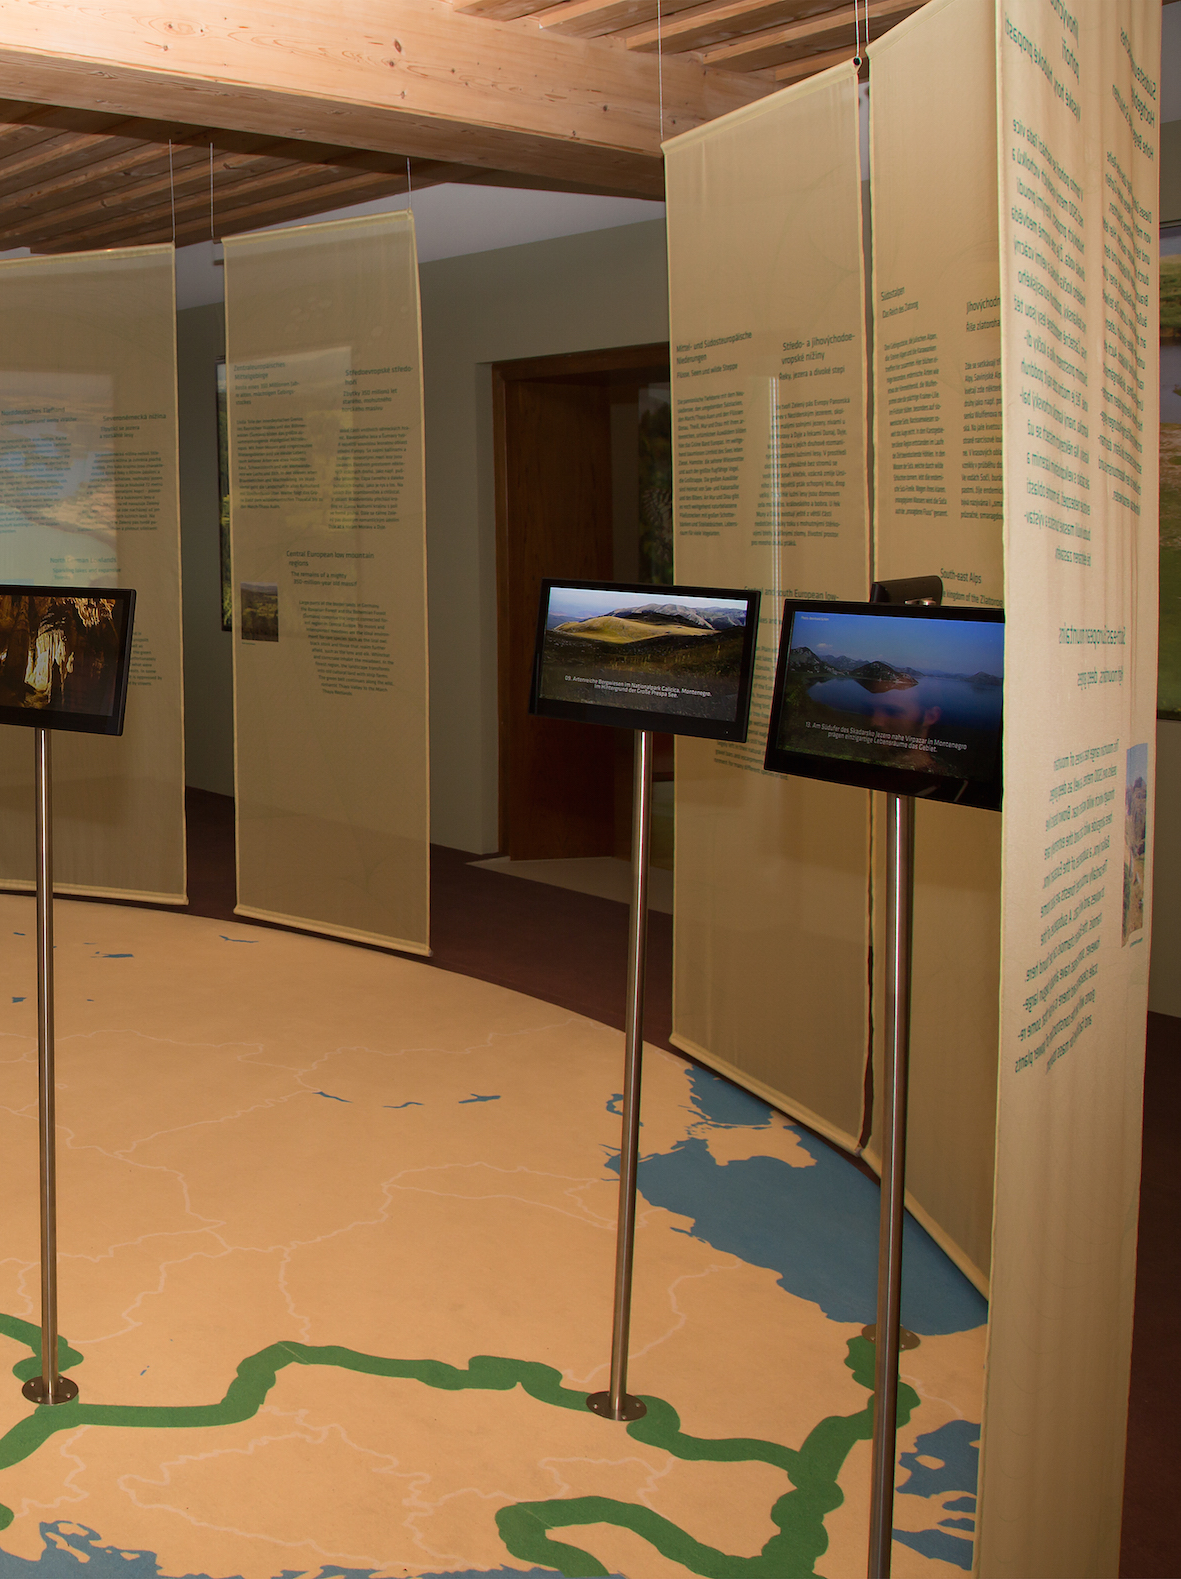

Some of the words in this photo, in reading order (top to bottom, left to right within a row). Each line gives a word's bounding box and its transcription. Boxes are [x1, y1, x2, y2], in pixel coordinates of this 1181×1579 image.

[966, 296, 1001, 315] Jihovýchodn
[307, 550, 333, 558] European
[970, 572, 982, 586] Alps
